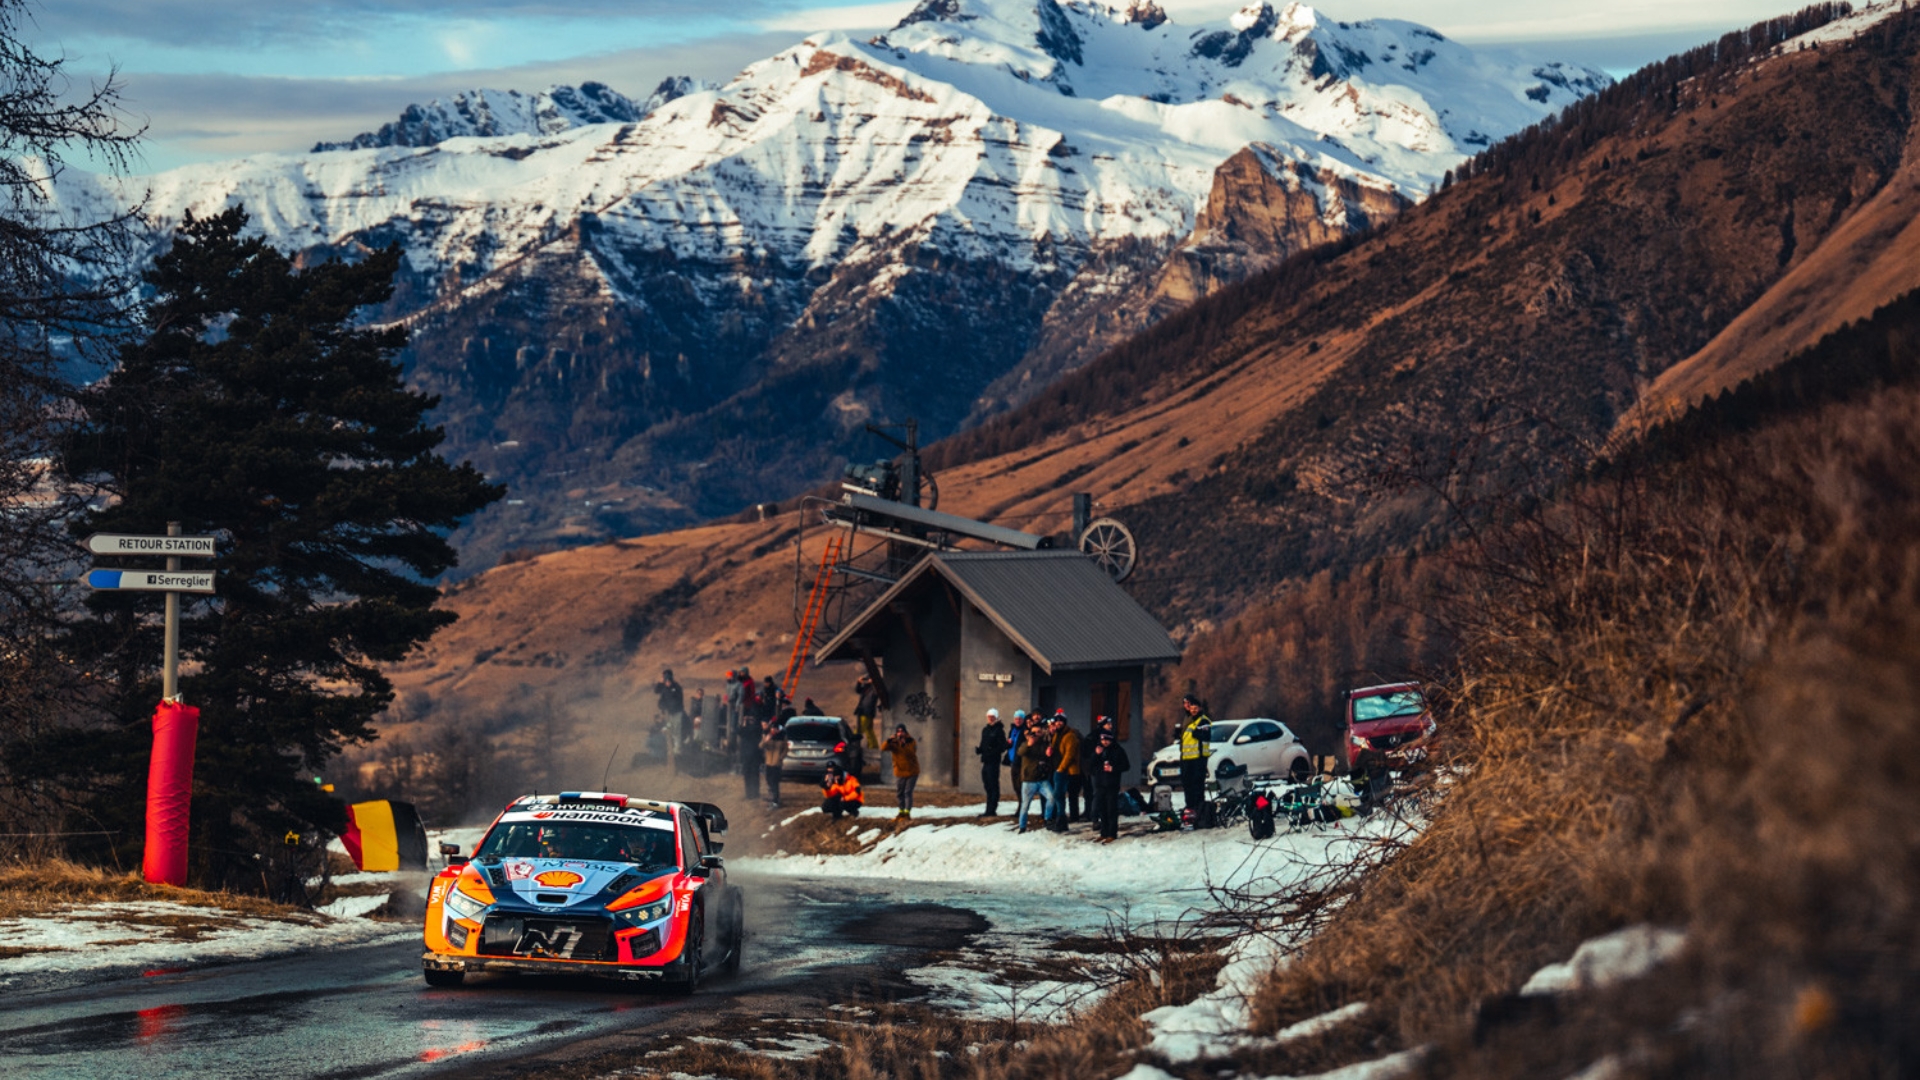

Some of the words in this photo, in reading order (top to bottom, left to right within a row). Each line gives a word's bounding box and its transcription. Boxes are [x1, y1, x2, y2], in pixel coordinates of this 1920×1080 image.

[119, 538, 163, 549] RETOUR
[165, 540, 211, 550] STATION
[158, 575, 210, 587] Serreglier
[542, 861, 619, 872] MOBIS
